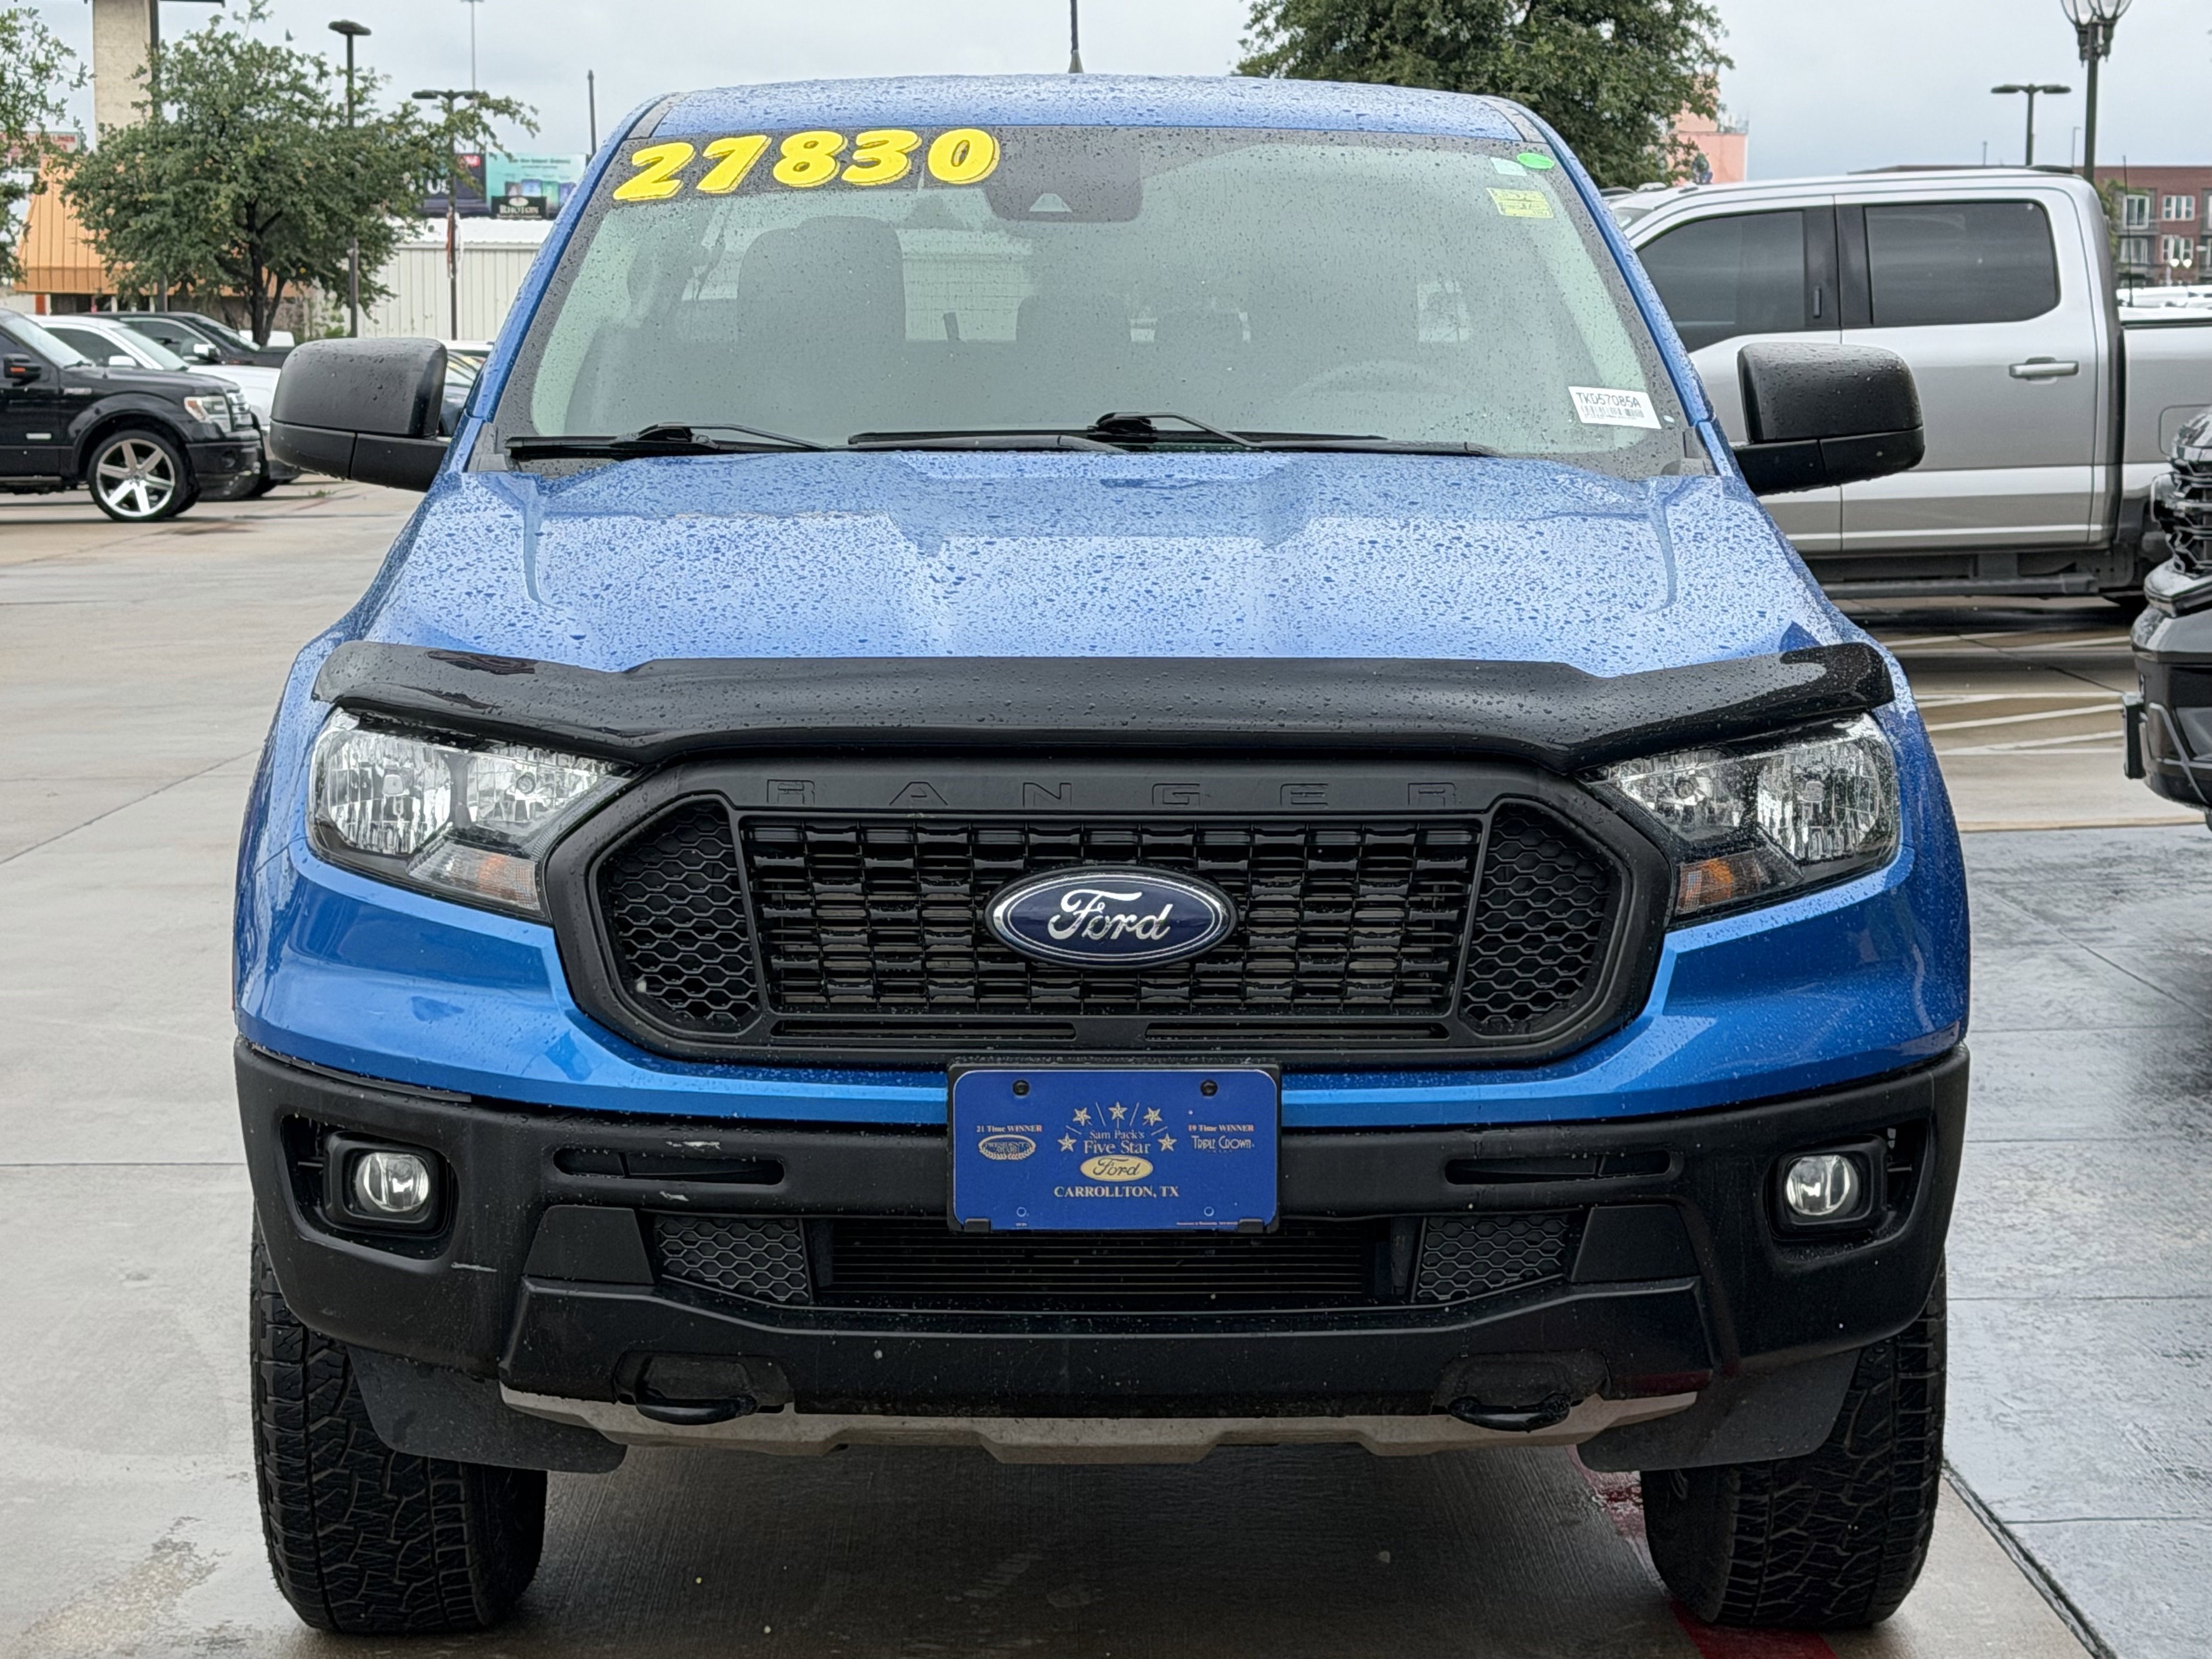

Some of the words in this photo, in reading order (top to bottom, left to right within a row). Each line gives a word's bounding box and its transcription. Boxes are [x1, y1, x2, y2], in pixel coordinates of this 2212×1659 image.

[613, 128, 1000, 201] 27830
[766, 778, 1457, 807] RANGER
[1047, 889, 1173, 940] Ford
[1007, 1124, 1042, 1133] WINNER
[1089, 1130, 1111, 1139] Sam
[1218, 1124, 1254, 1132] WINNER
[1084, 1139, 1116, 1154] Five
[1120, 1139, 1151, 1154] Star
[1092, 1157, 1141, 1176] Ford
[1053, 1186, 1157, 1198] CARROLLTON,
[1159, 1186, 1180, 1198] TX
